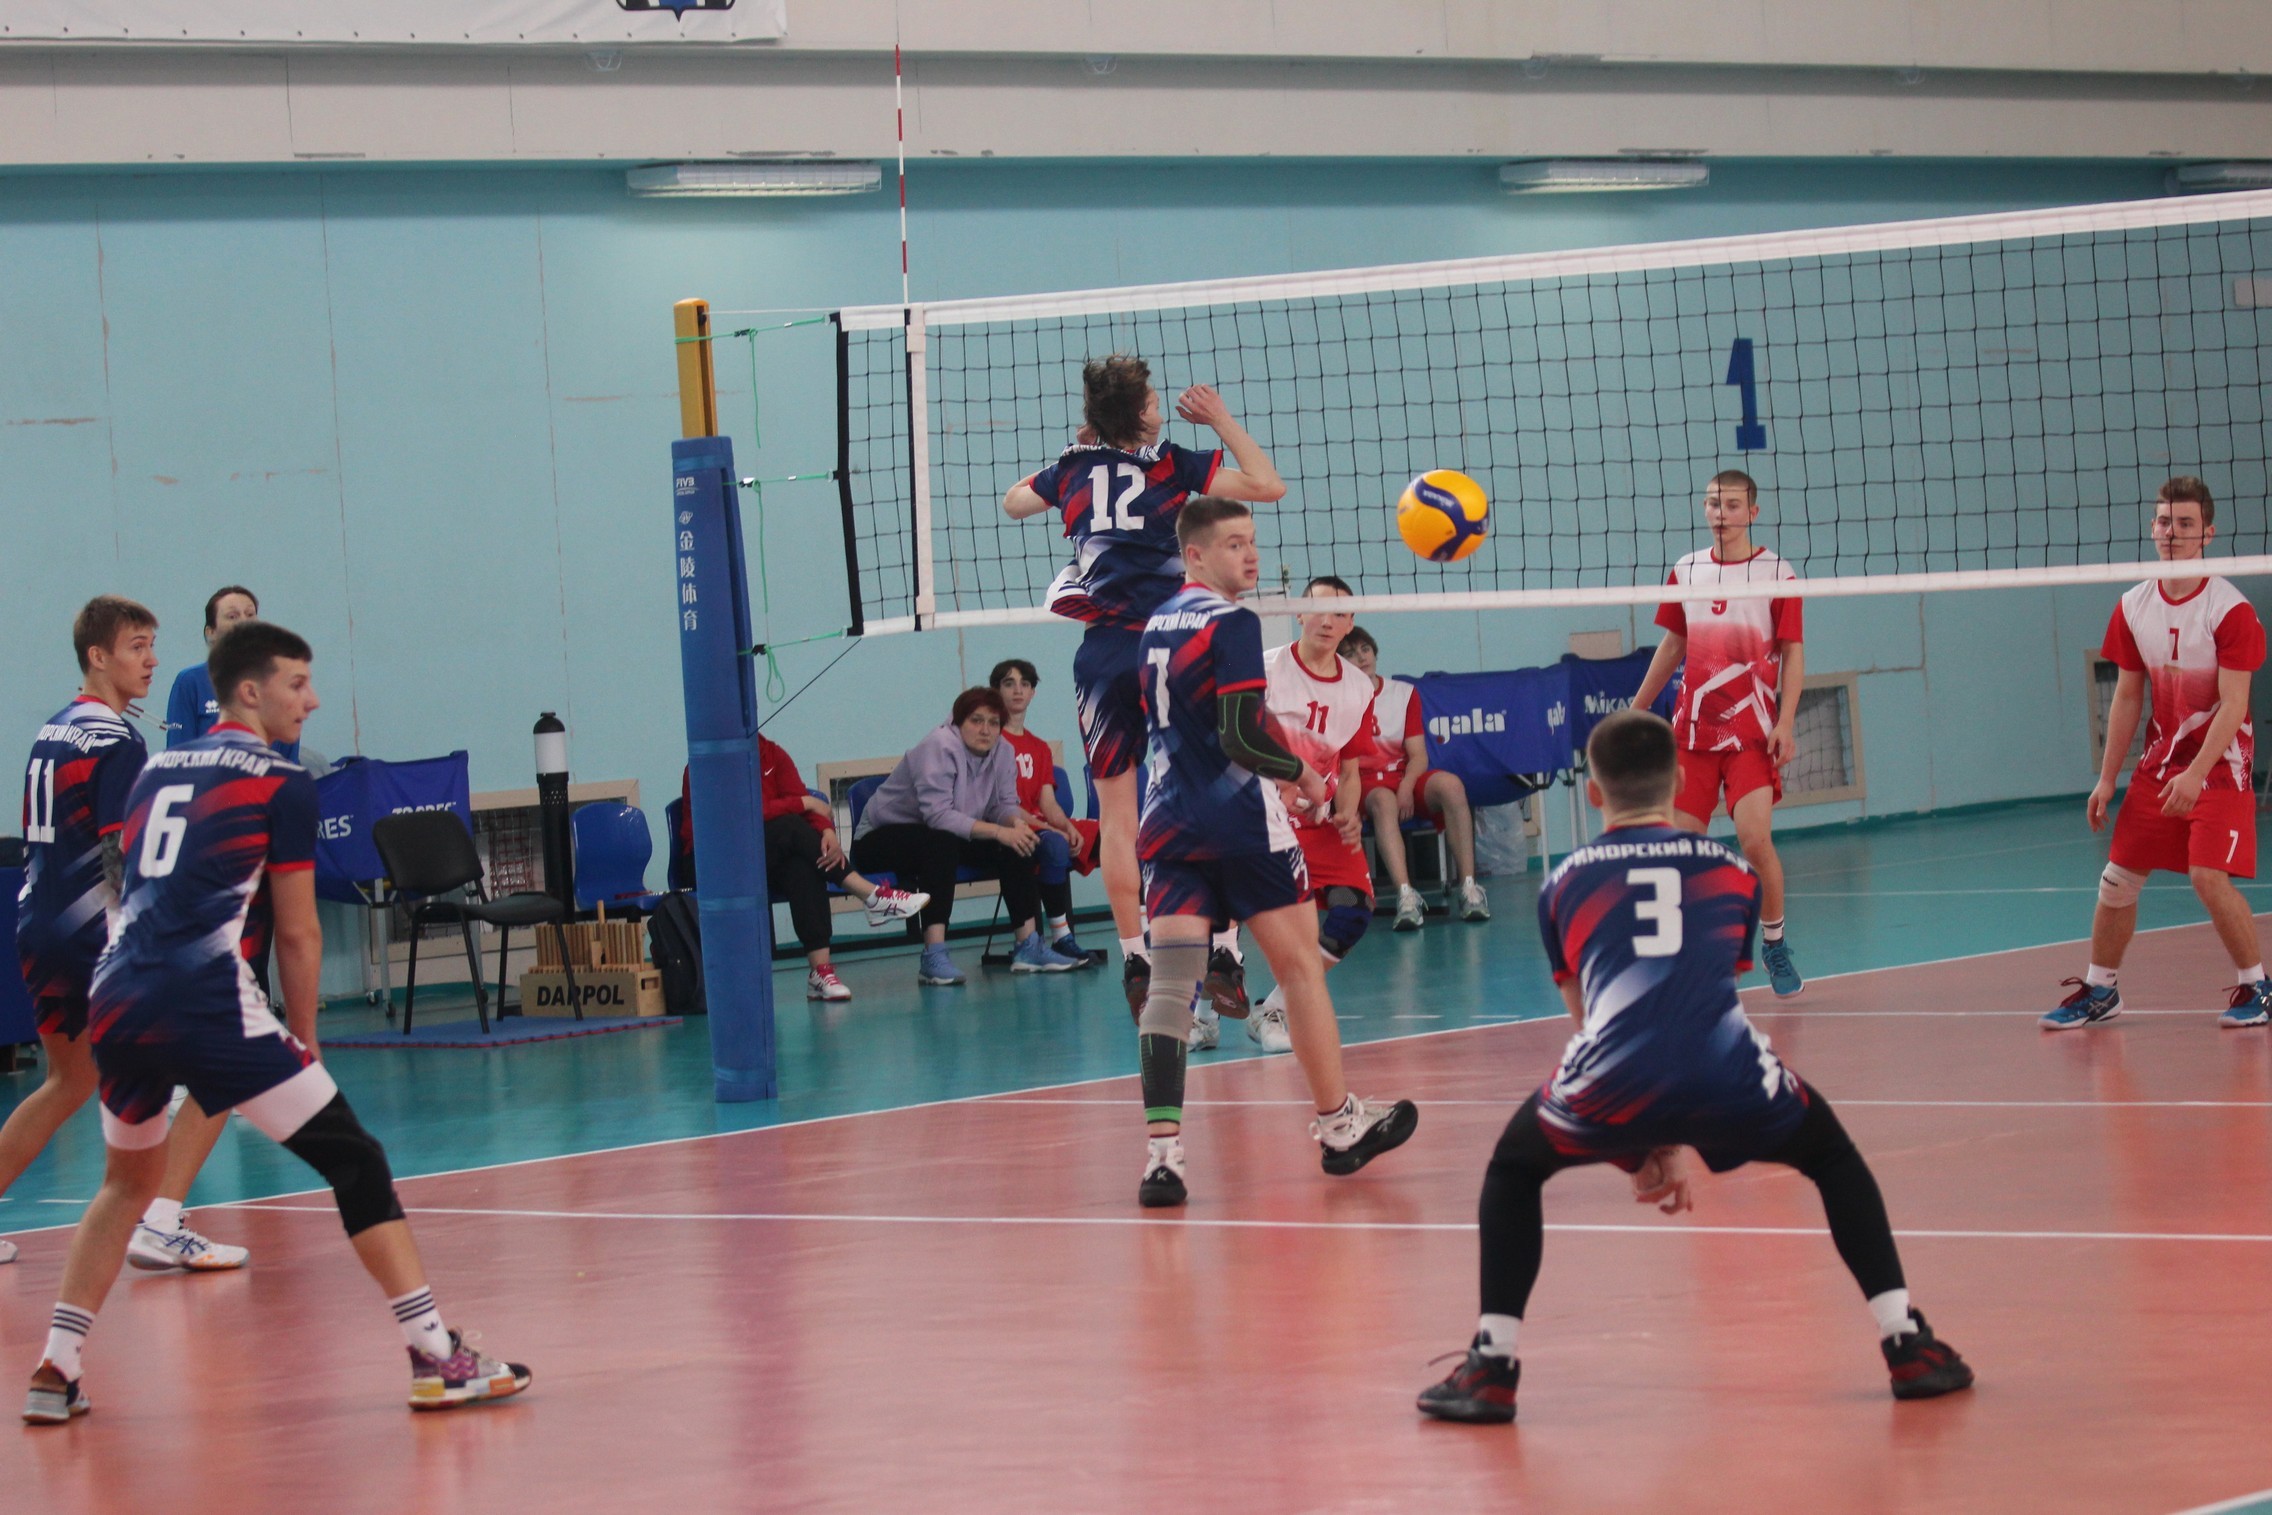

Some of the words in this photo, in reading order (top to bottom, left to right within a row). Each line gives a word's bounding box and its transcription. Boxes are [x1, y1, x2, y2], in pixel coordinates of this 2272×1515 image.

[1726, 338, 1767, 451] 1
[1088, 462, 1145, 533] 12
[679, 530, 698, 631] 金陵体育
[2169, 628, 2180, 661] 7
[1147, 647, 1171, 729] 7
[1306, 701, 1329, 734] 11
[1429, 708, 1505, 745] gala
[219, 748, 271, 777] КРАЙ
[1016, 752, 1034, 779] 13
[27, 758, 55, 843] 11
[317, 814, 355, 840] RES
[138, 784, 195, 878] 6
[2225, 830, 2239, 864] 7
[1626, 867, 1683, 958] 3
